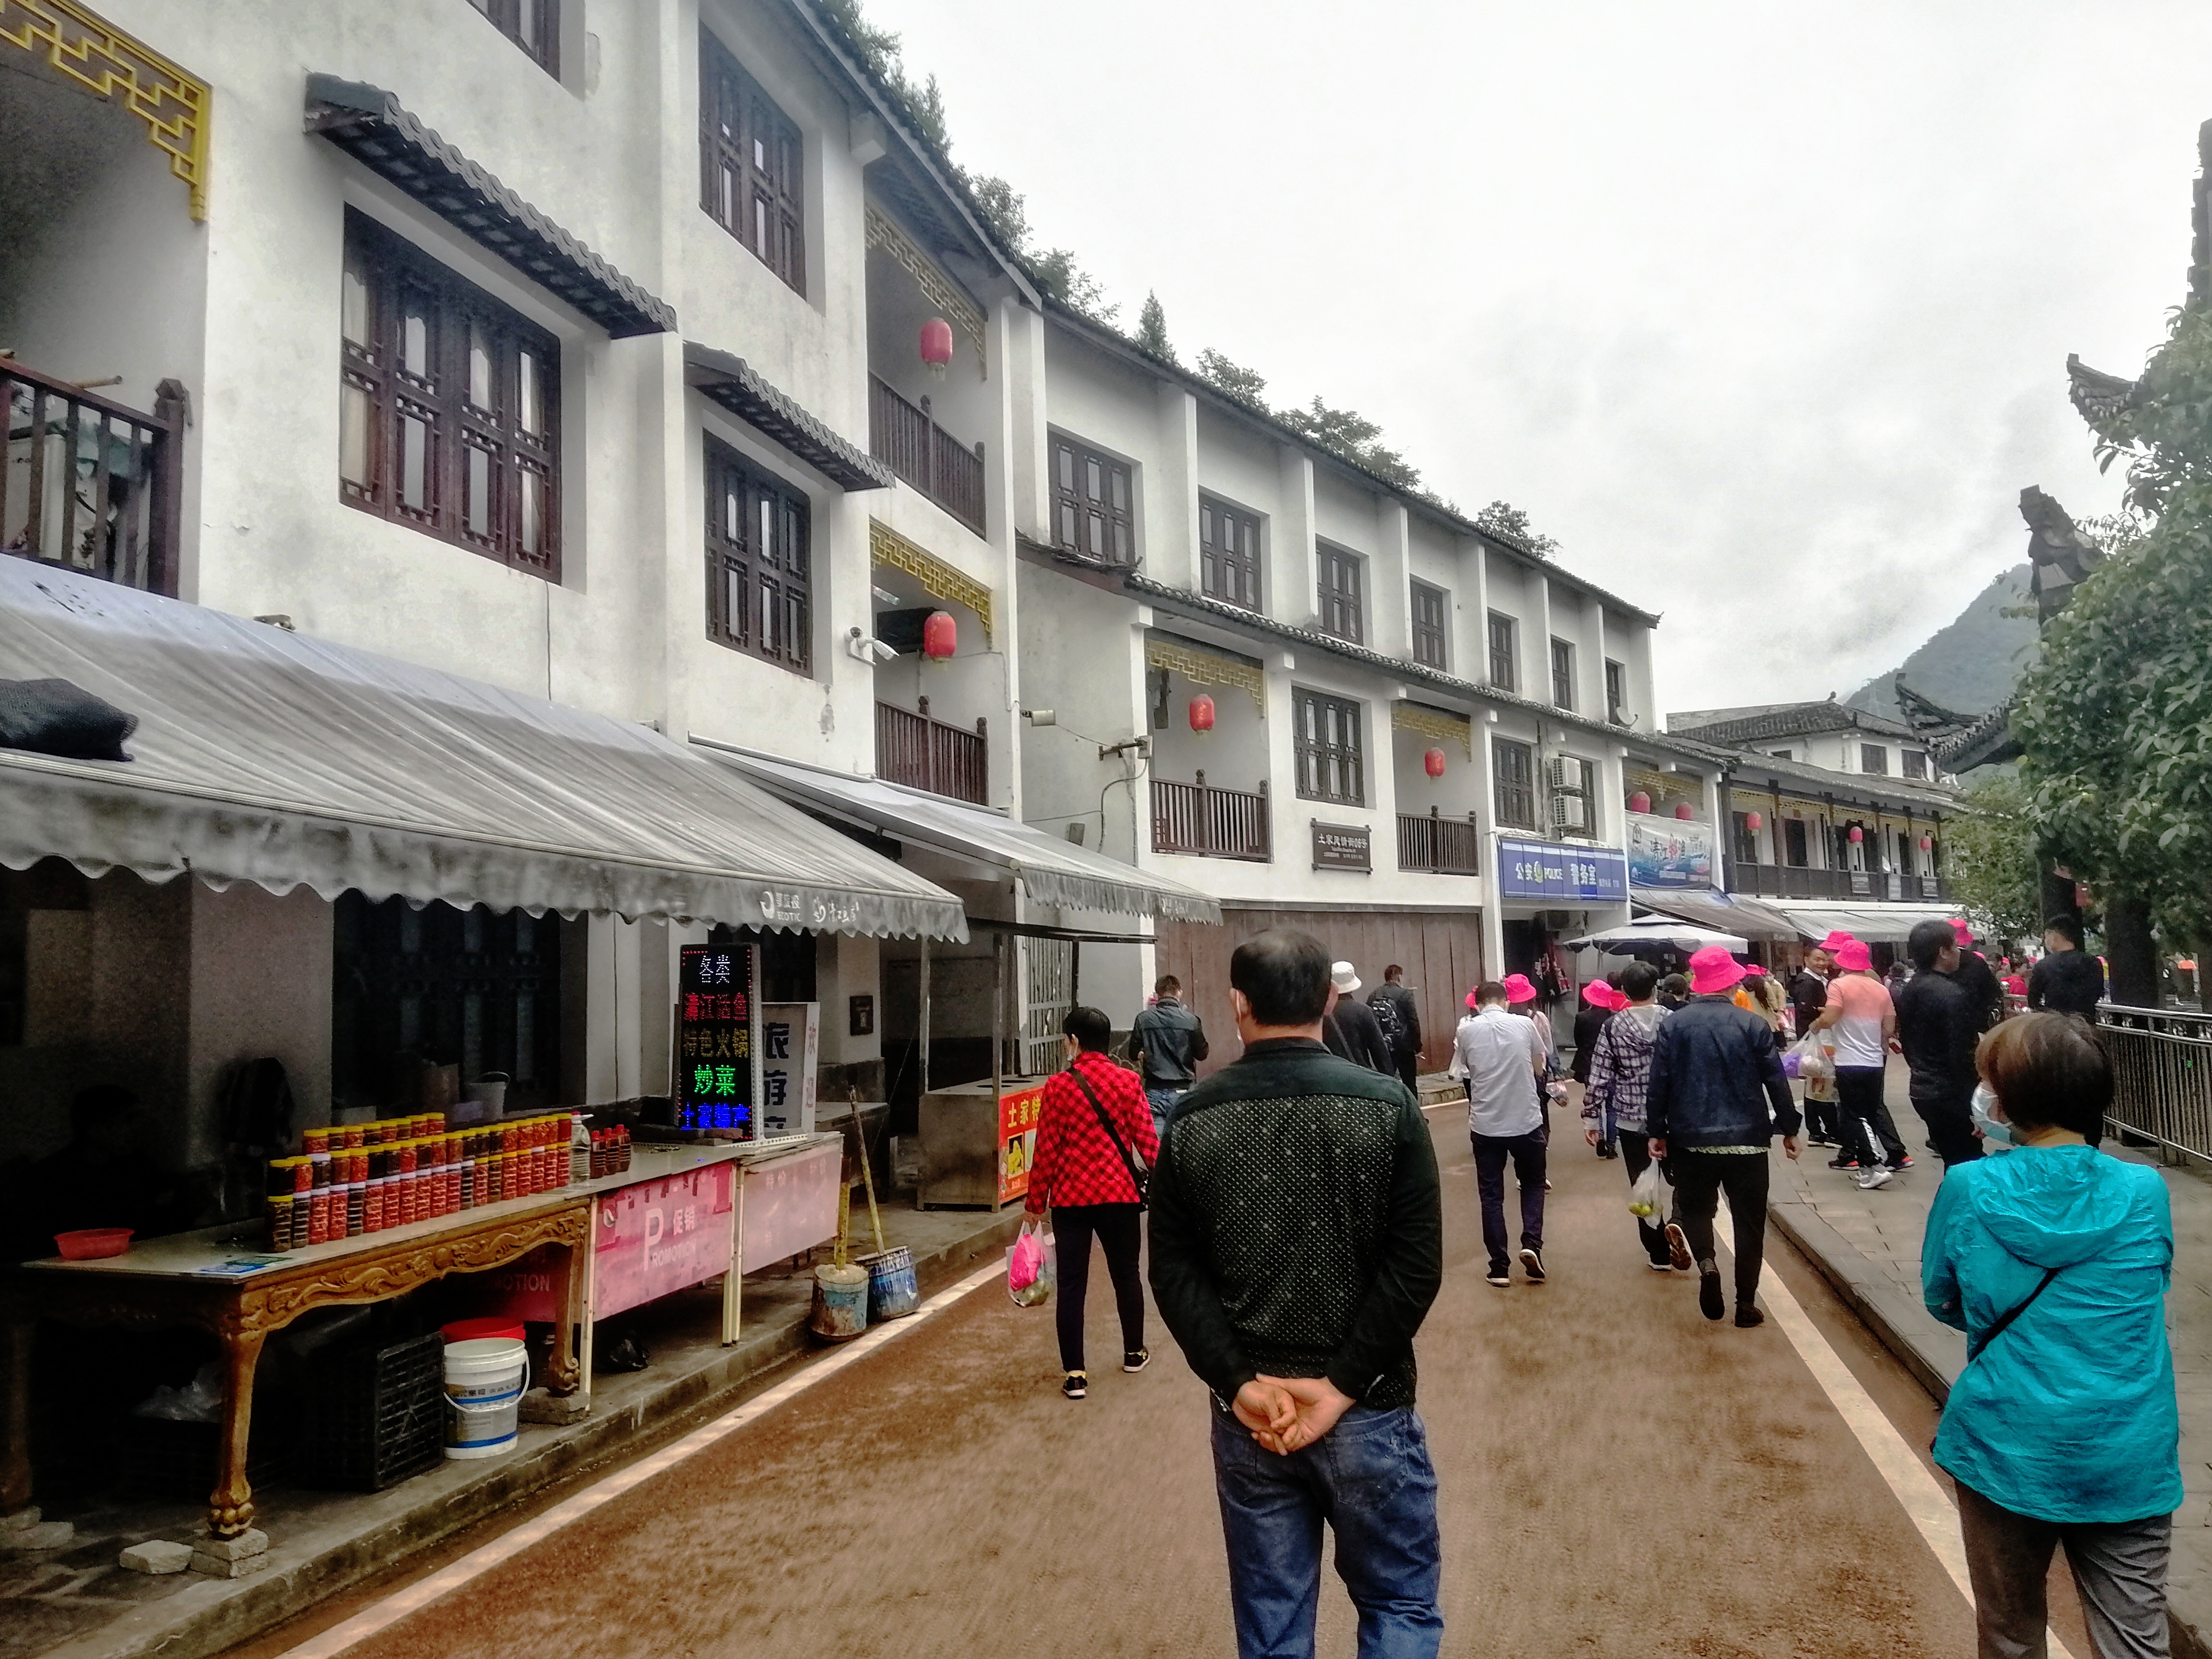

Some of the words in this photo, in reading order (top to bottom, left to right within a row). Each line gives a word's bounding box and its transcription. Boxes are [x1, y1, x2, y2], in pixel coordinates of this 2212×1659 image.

[1515, 863, 1533, 881] 公安
[1543, 867, 1563, 880] POLICE
[1570, 863, 1597, 887] 警务室
[699, 954, 731, 984] 各类
[683, 1027, 749, 1058] 特色火锅
[694, 1064, 736, 1097] 炒菜
[680, 1102, 750, 1130] 土家特产
[673, 1204, 696, 1236] 促销
